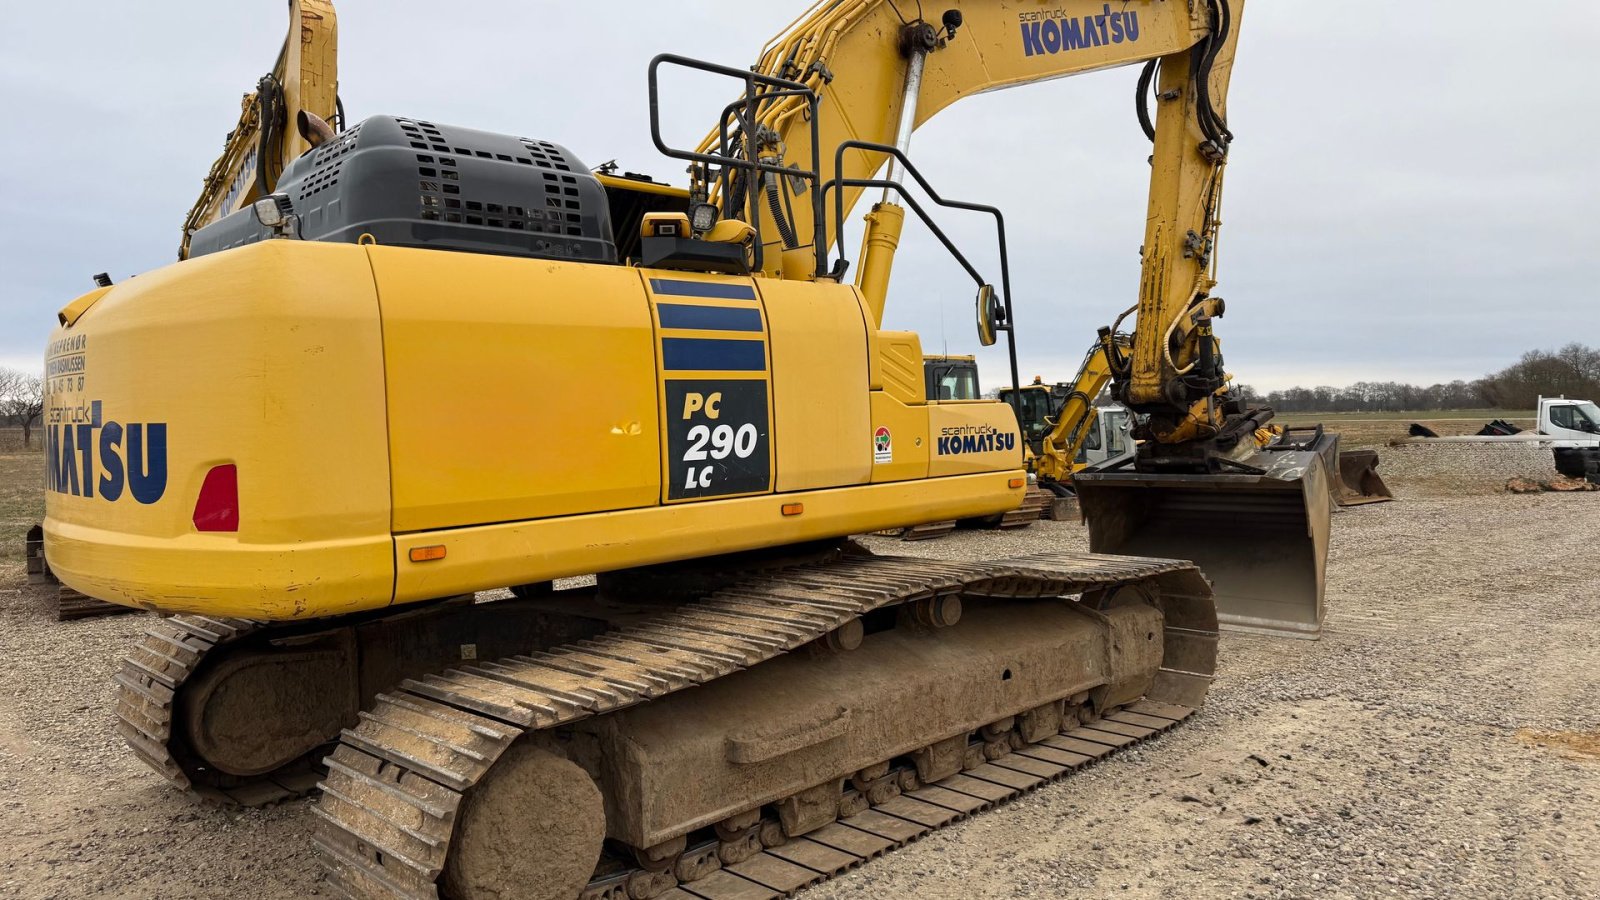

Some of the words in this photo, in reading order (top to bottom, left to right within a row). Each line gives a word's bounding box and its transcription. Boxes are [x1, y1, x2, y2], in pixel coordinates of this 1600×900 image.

[1018, 6, 1067, 22] scantruck
[1020, 4, 1139, 57] KOMATSU
[77, 376, 85, 391] 87
[50, 399, 90, 423] scantruck
[682, 392, 722, 420] PC
[682, 422, 758, 462] 290
[937, 428, 1015, 455] KOMATSU
[941, 423, 992, 436] scantruck
[46, 400, 167, 505] MATSU
[684, 465, 714, 489] LC
